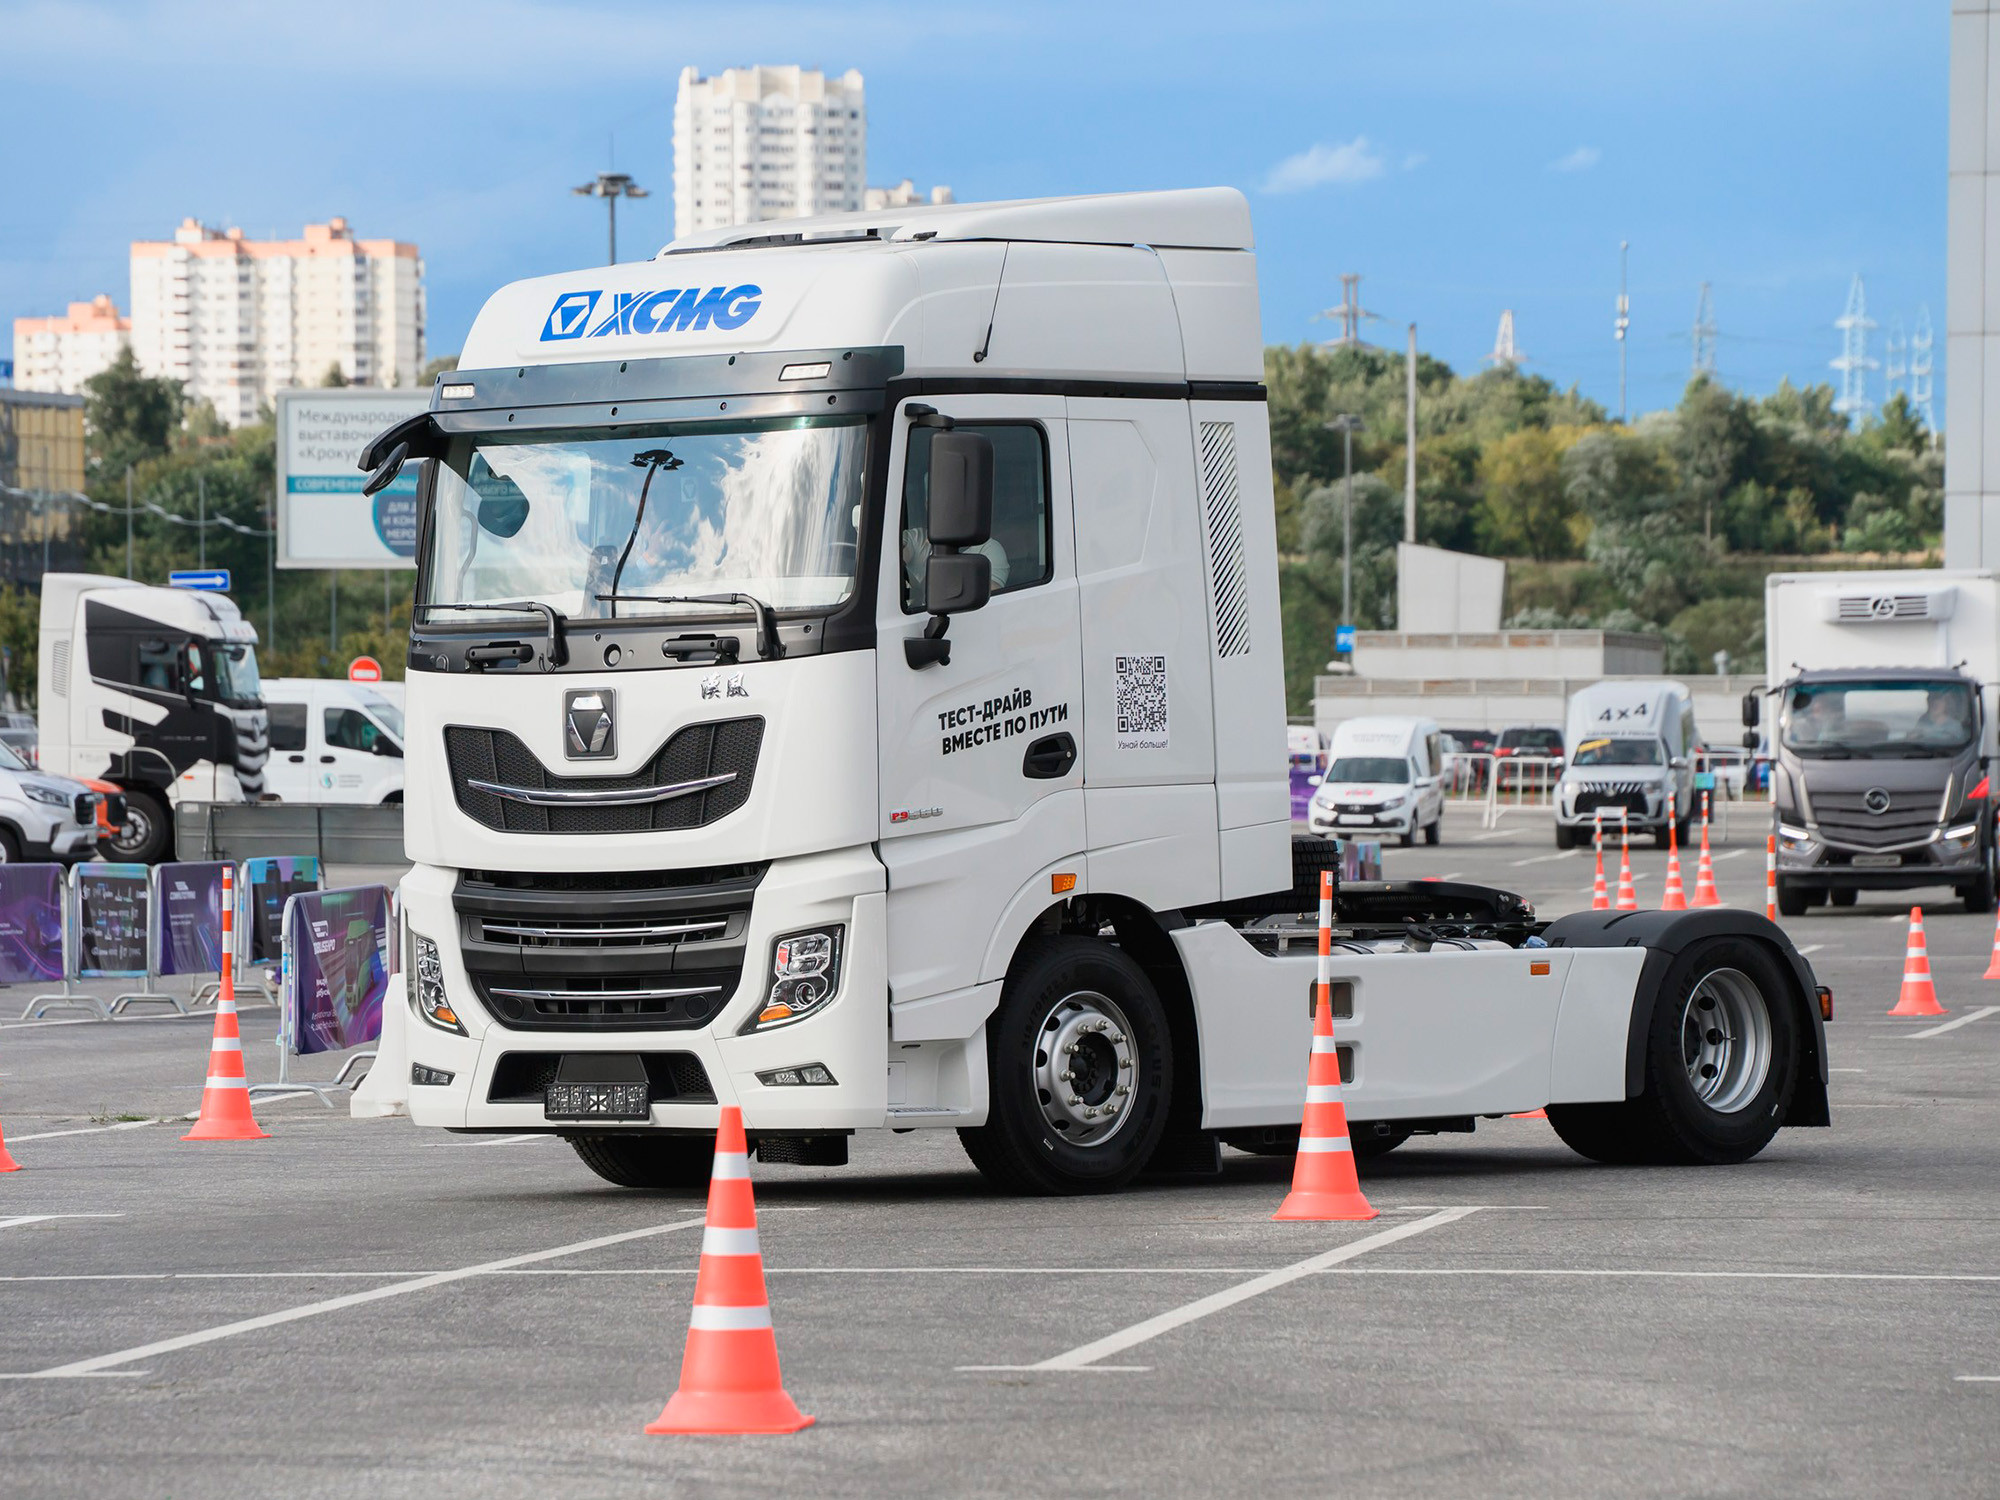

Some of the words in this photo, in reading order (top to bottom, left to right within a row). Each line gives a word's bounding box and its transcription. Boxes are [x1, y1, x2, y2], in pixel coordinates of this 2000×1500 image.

[587, 284, 763, 338] XCMG
[298, 408, 412, 425] Международн
[298, 431, 379, 441] выставочн
[938, 687, 1032, 731] ТЕСТ-ДРАЙВ
[942, 725, 1001, 755] ВМЕСТЕ
[1004, 715, 1026, 738] ПО
[1029, 702, 1068, 731] ПУТИ
